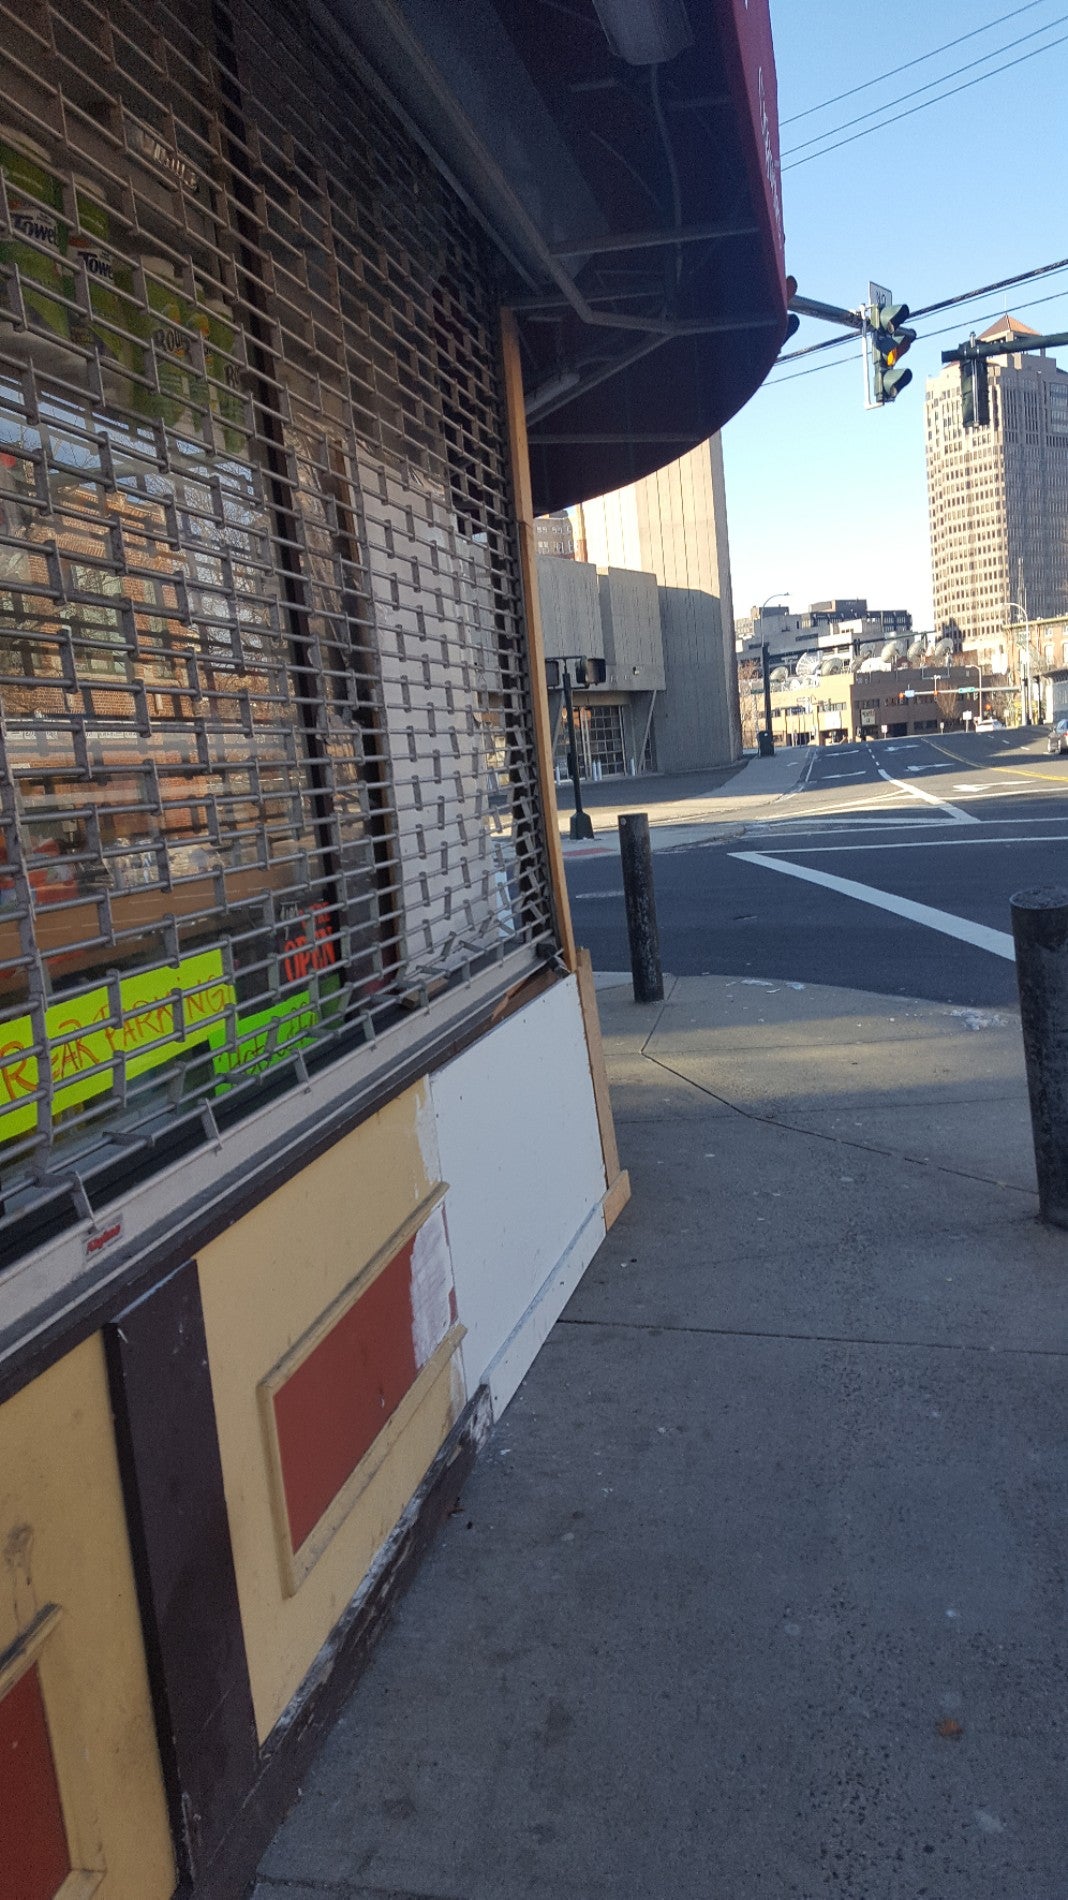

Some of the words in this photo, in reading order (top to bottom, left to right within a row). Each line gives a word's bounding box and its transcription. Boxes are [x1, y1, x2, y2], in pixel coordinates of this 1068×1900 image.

[284, 925, 337, 983] OPEN
[0, 1018, 101, 1101] REAR
[93, 975, 226, 1051] PARKNG
